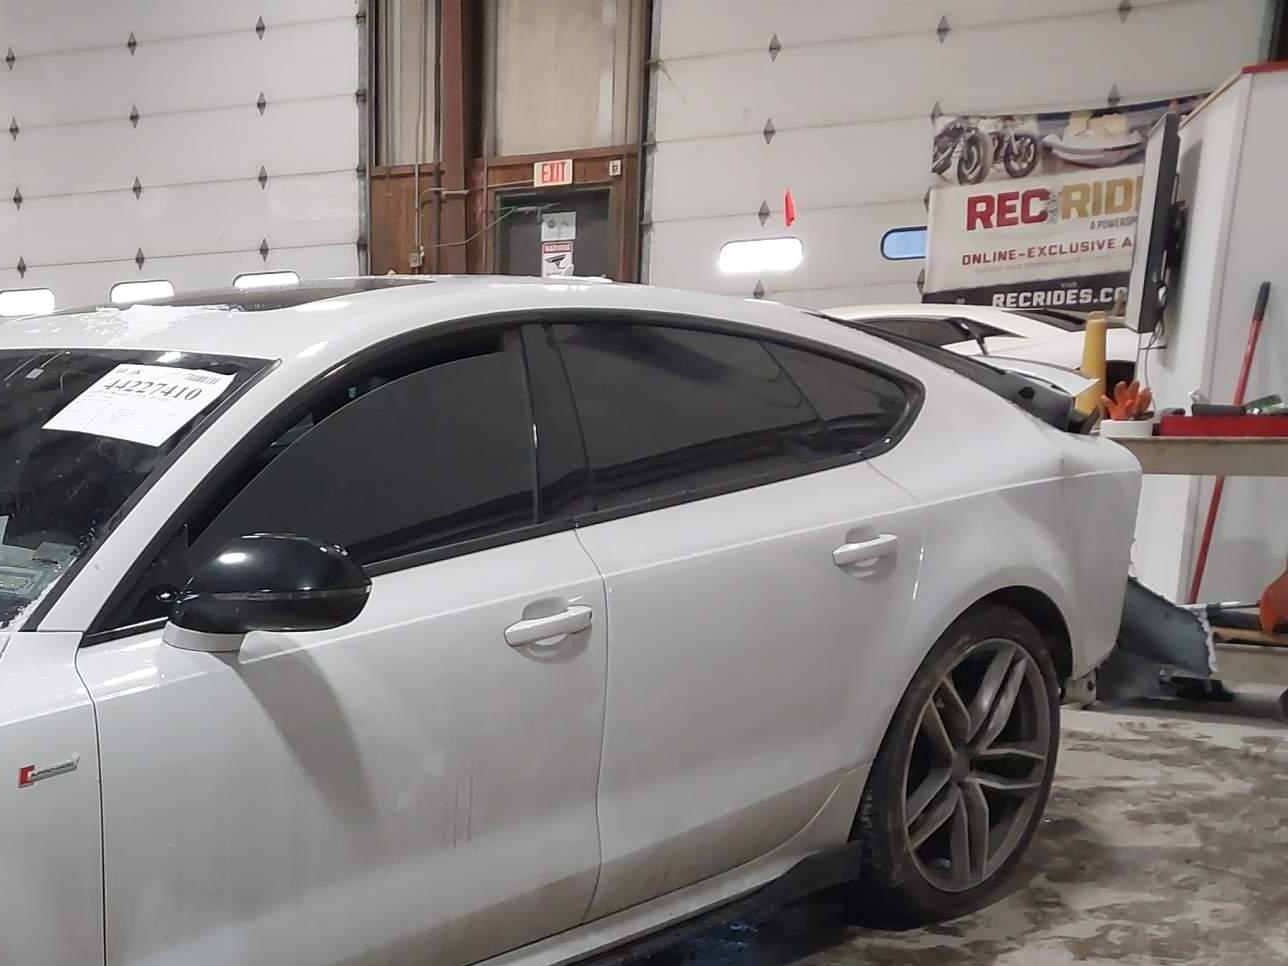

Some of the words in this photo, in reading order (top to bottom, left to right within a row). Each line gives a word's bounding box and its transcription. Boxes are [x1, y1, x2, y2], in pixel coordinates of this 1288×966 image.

[541, 162, 566, 184] EXIT
[966, 188, 1049, 231] REC
[962, 238, 1116, 266] ONLINE-EXCLUSIVE
[103, 378, 203, 401] 44227410
